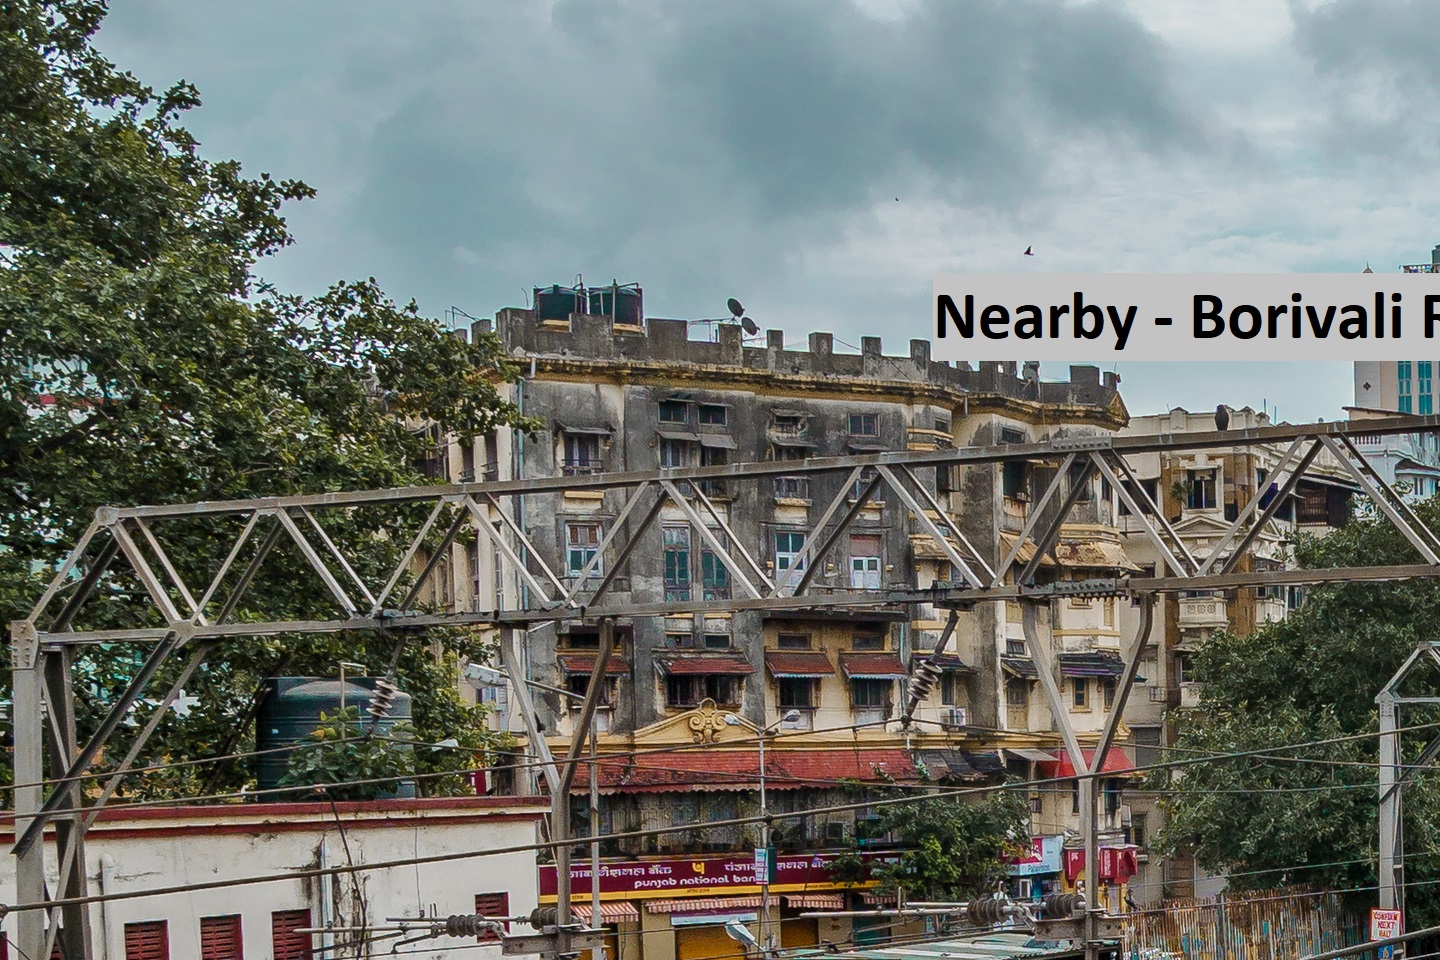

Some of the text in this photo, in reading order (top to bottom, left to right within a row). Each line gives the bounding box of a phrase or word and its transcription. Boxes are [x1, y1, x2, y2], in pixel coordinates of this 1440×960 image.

[634, 875, 756, 889] punjab national ban
[1377, 921, 1396, 930] NEXT
